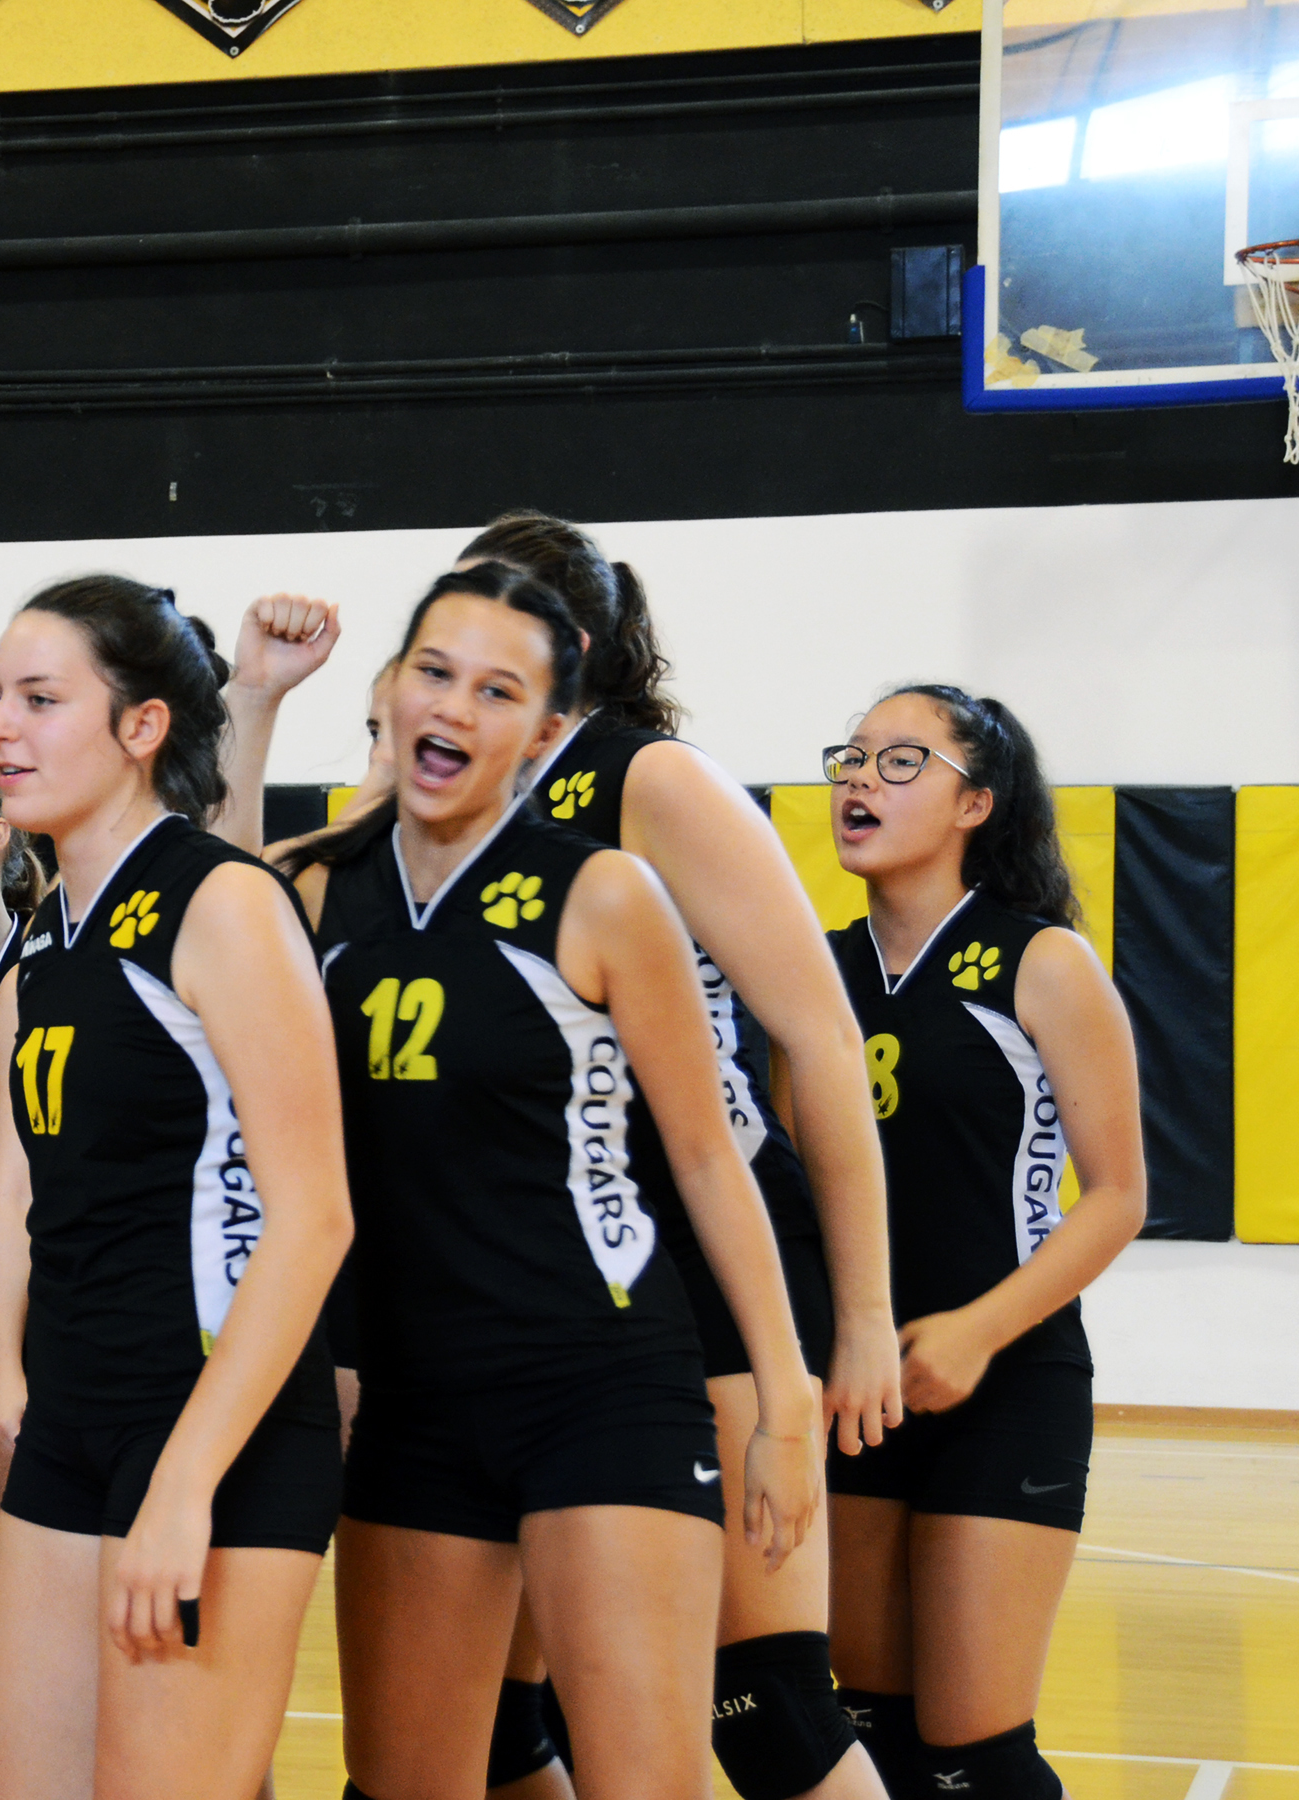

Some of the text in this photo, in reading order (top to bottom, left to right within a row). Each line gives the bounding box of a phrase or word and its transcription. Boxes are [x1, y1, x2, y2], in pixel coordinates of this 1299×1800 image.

[360, 977, 444, 1080] 12
[864, 1033, 900, 1120] 8
[16, 1026, 75, 1135] 17
[580, 1035, 637, 1249] COUGARS
[711, 1693, 757, 1720] LSIX
